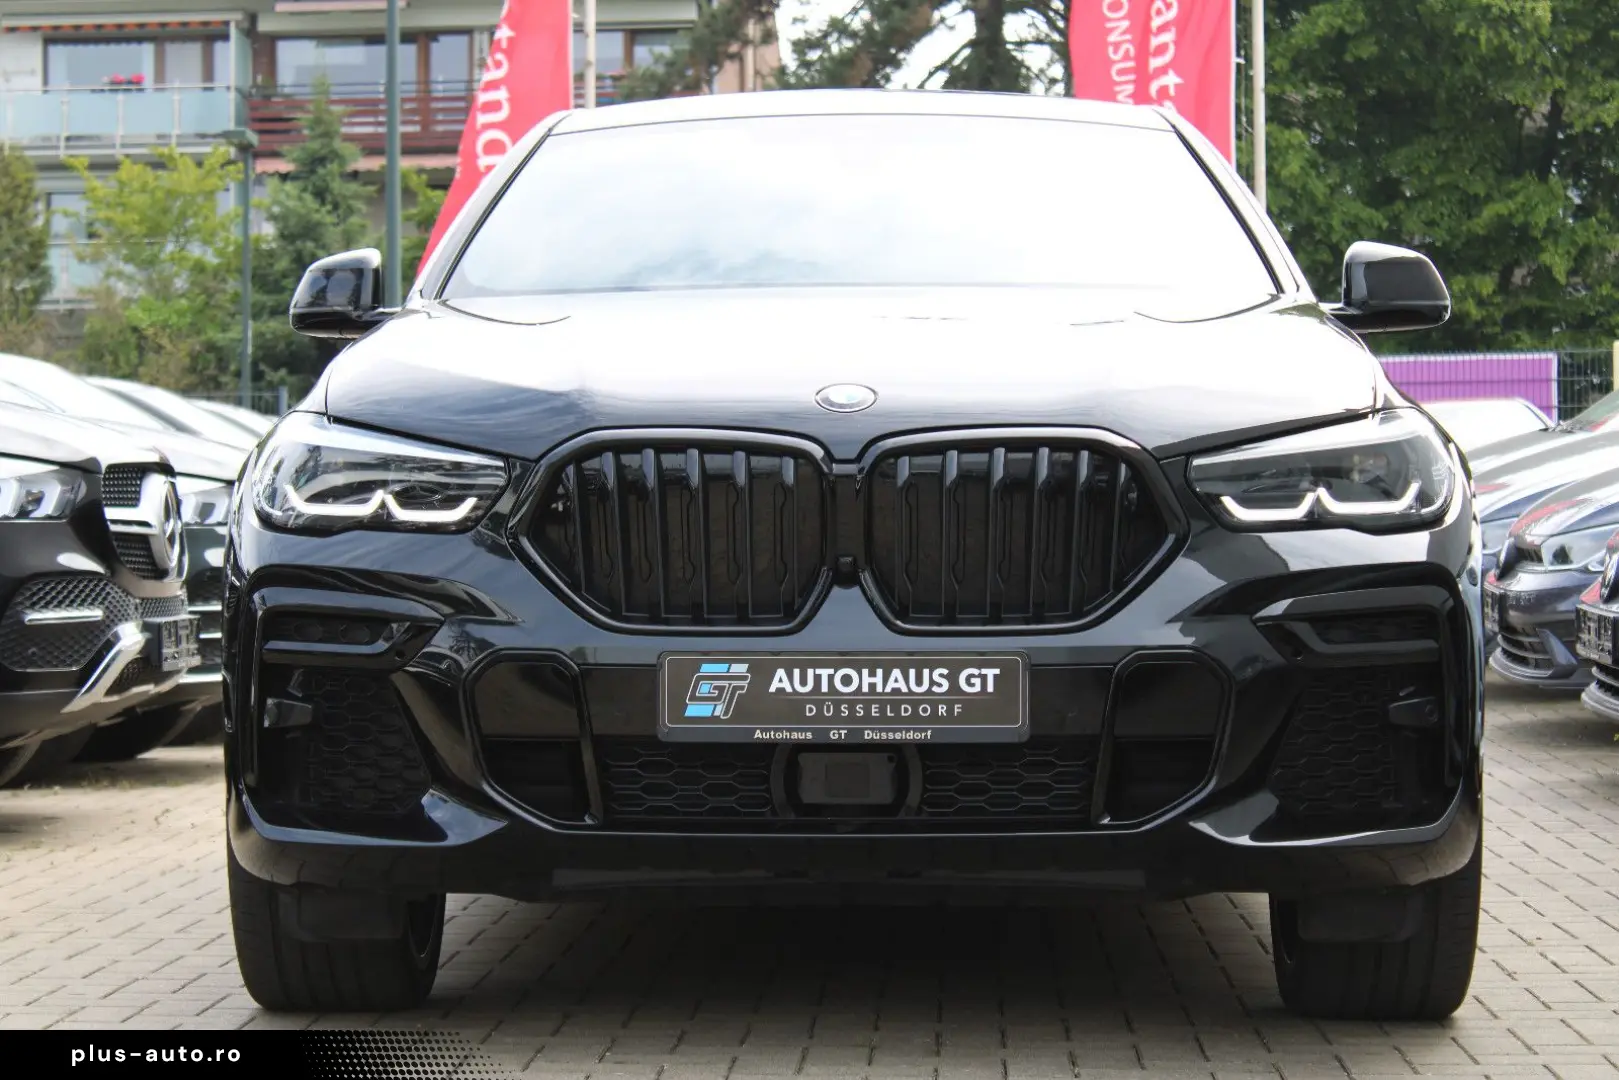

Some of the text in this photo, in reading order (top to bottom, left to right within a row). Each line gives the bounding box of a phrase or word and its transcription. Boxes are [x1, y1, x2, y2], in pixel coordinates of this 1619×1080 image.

[768, 667, 1001, 693] AUTOHAUS GT
[805, 701, 963, 717] DÜSSELDORF
[754, 729, 932, 740] Autohaus GT Düsseldorf
